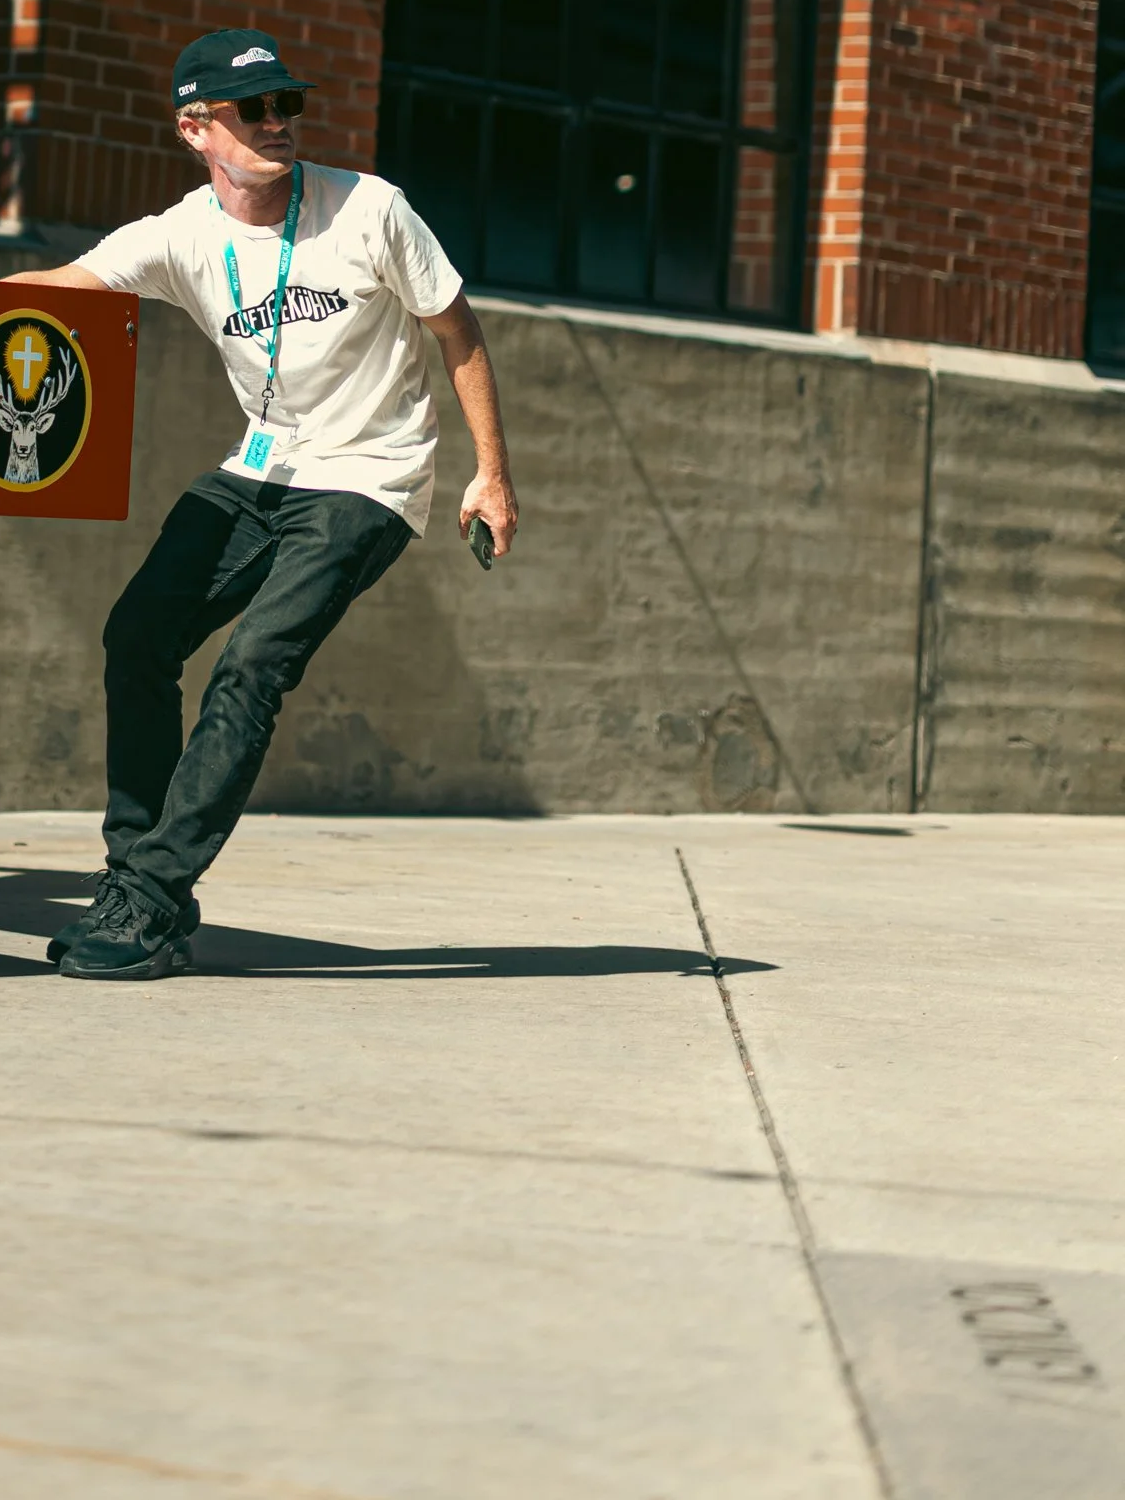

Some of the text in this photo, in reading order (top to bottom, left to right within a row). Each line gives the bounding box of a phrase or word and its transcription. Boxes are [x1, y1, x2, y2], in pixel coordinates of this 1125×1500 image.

[178, 81, 197, 96] CREW
[287, 192, 299, 226] AMERICAN
[229, 256, 240, 291] AMERICAN
[280, 240, 291, 276] AMERICAN
